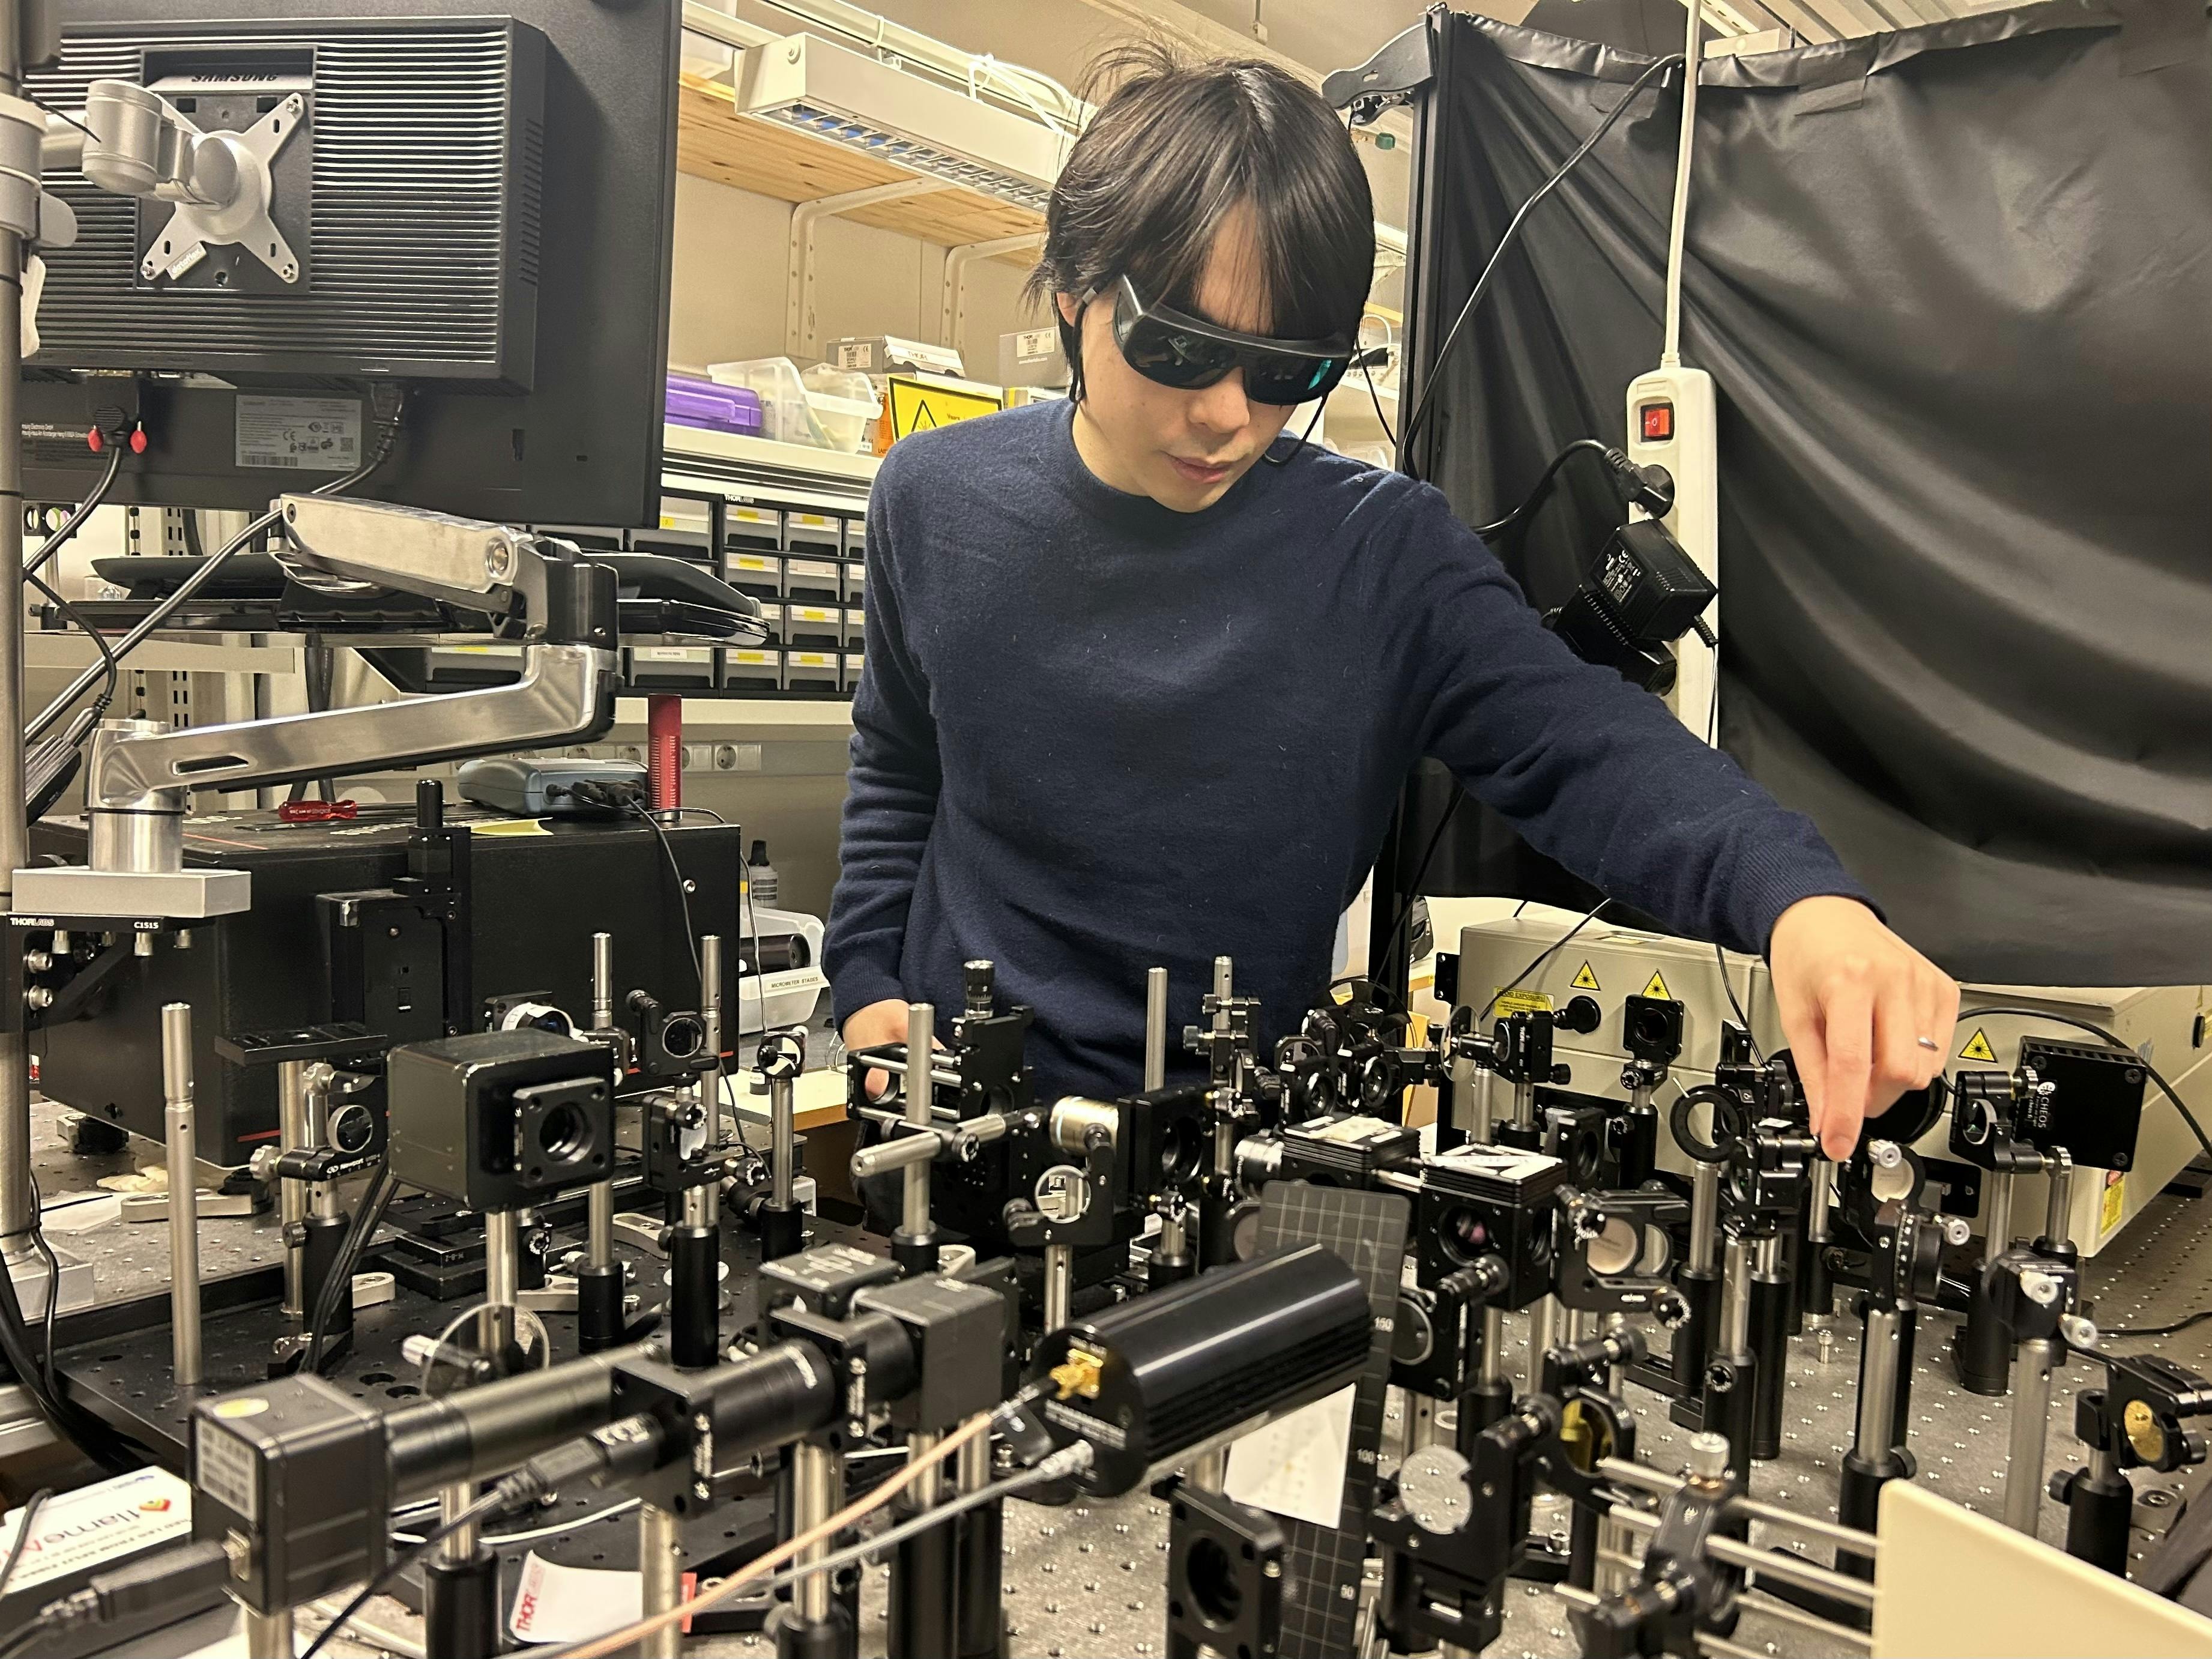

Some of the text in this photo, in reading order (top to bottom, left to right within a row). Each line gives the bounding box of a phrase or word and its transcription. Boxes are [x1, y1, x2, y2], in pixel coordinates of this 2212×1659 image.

[191, 74, 279, 82] SAMSUNG
[10, 917, 55, 927] THORLABS
[771, 979, 800, 988] MICROMETER
[2037, 1096, 2050, 1128] CHEOS
[1374, 1317, 1394, 1332] 150
[1356, 1449, 1374, 1464] 100
[1340, 1585, 1355, 1600] 50
